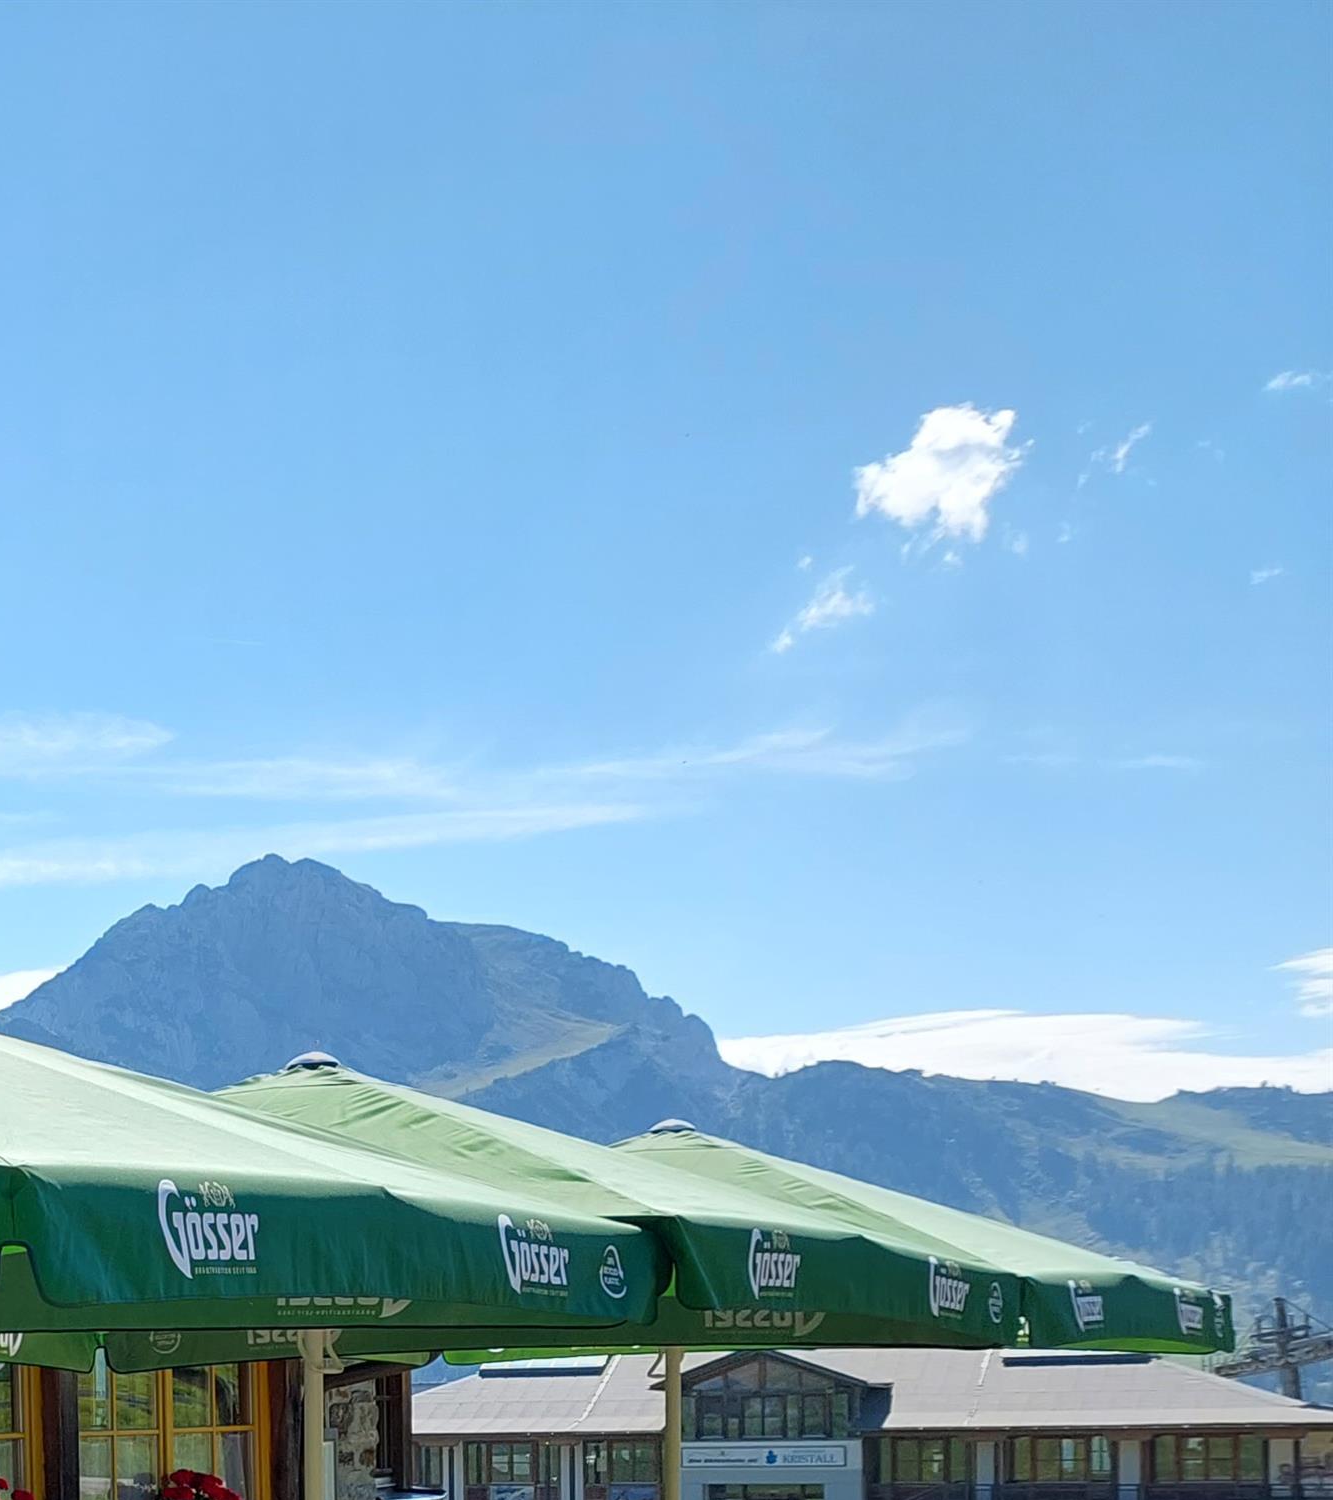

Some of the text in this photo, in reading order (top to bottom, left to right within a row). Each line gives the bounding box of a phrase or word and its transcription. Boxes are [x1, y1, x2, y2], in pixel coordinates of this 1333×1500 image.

[158, 1179, 259, 1279] Gösser
[498, 1213, 569, 1295] Gösser
[748, 1227, 801, 1300] Gösser
